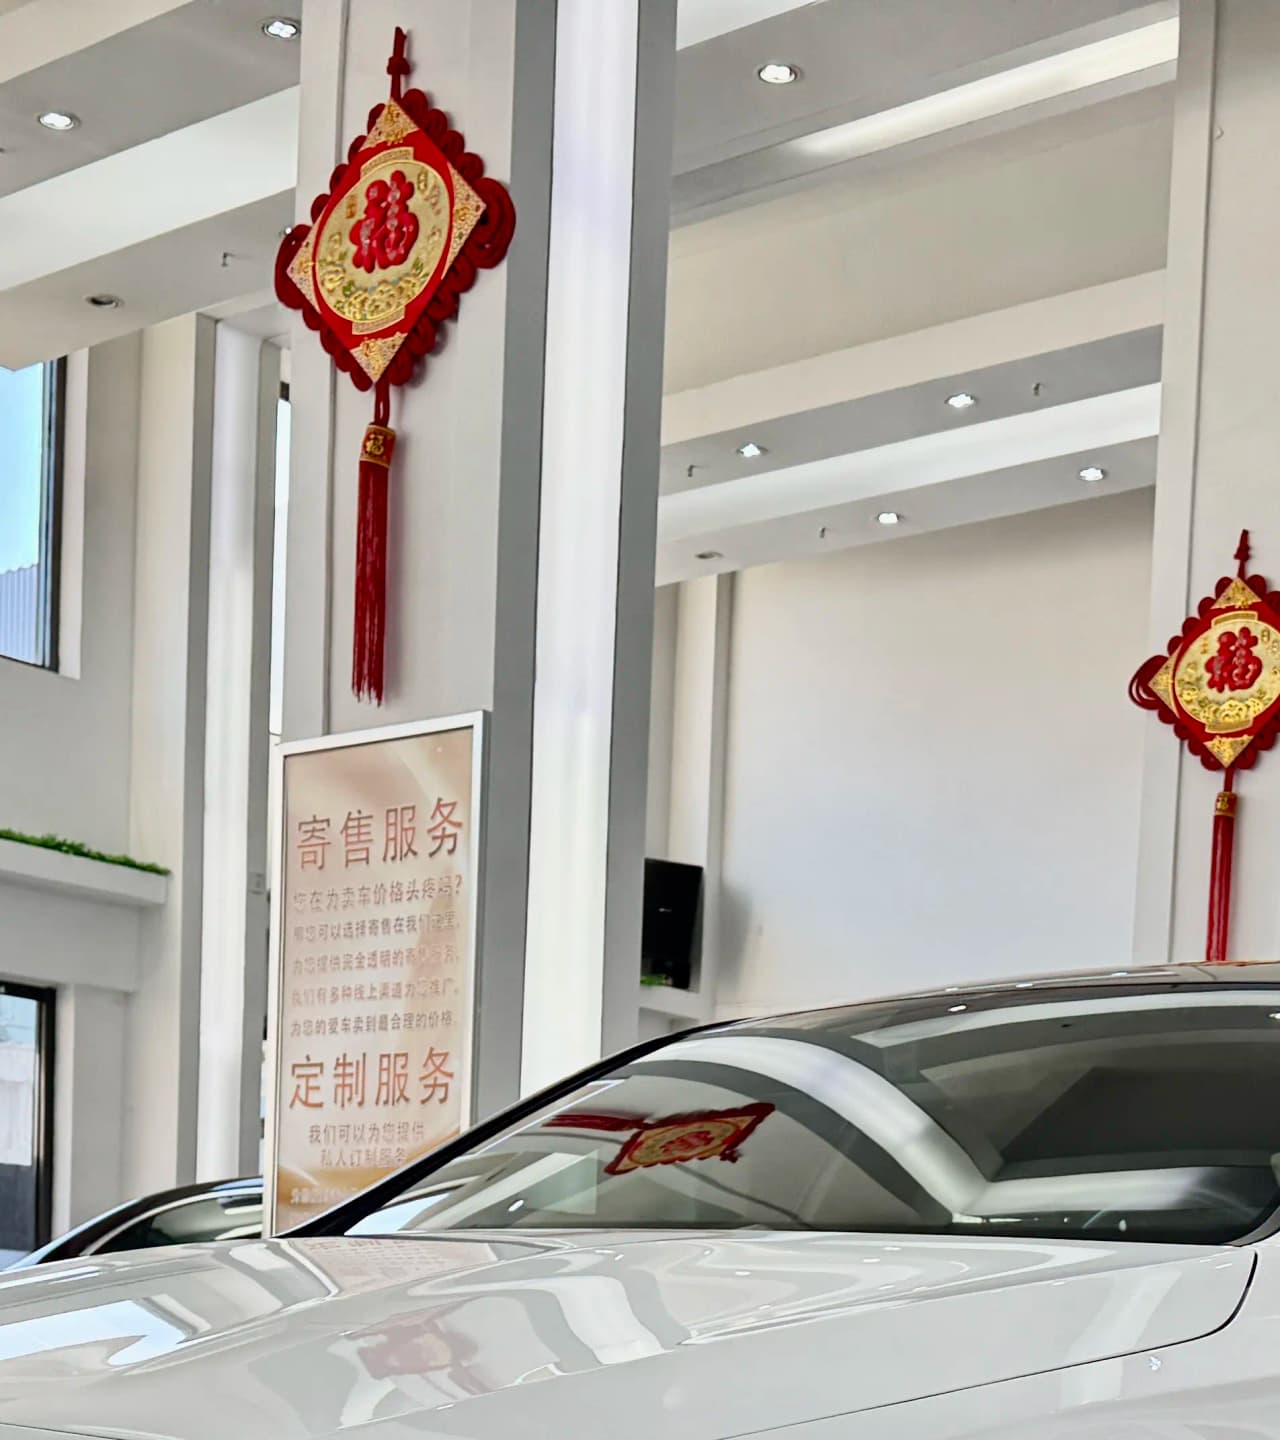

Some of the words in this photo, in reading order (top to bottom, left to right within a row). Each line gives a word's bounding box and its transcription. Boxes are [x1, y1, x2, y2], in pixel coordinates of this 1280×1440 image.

[349, 170, 420, 273] 福
[1204, 626, 1263, 694] 福
[297, 797, 463, 870] 寄售服务
[289, 1046, 454, 1110] 定制服务
[309, 1120, 424, 1145] 我们可以为您提供
